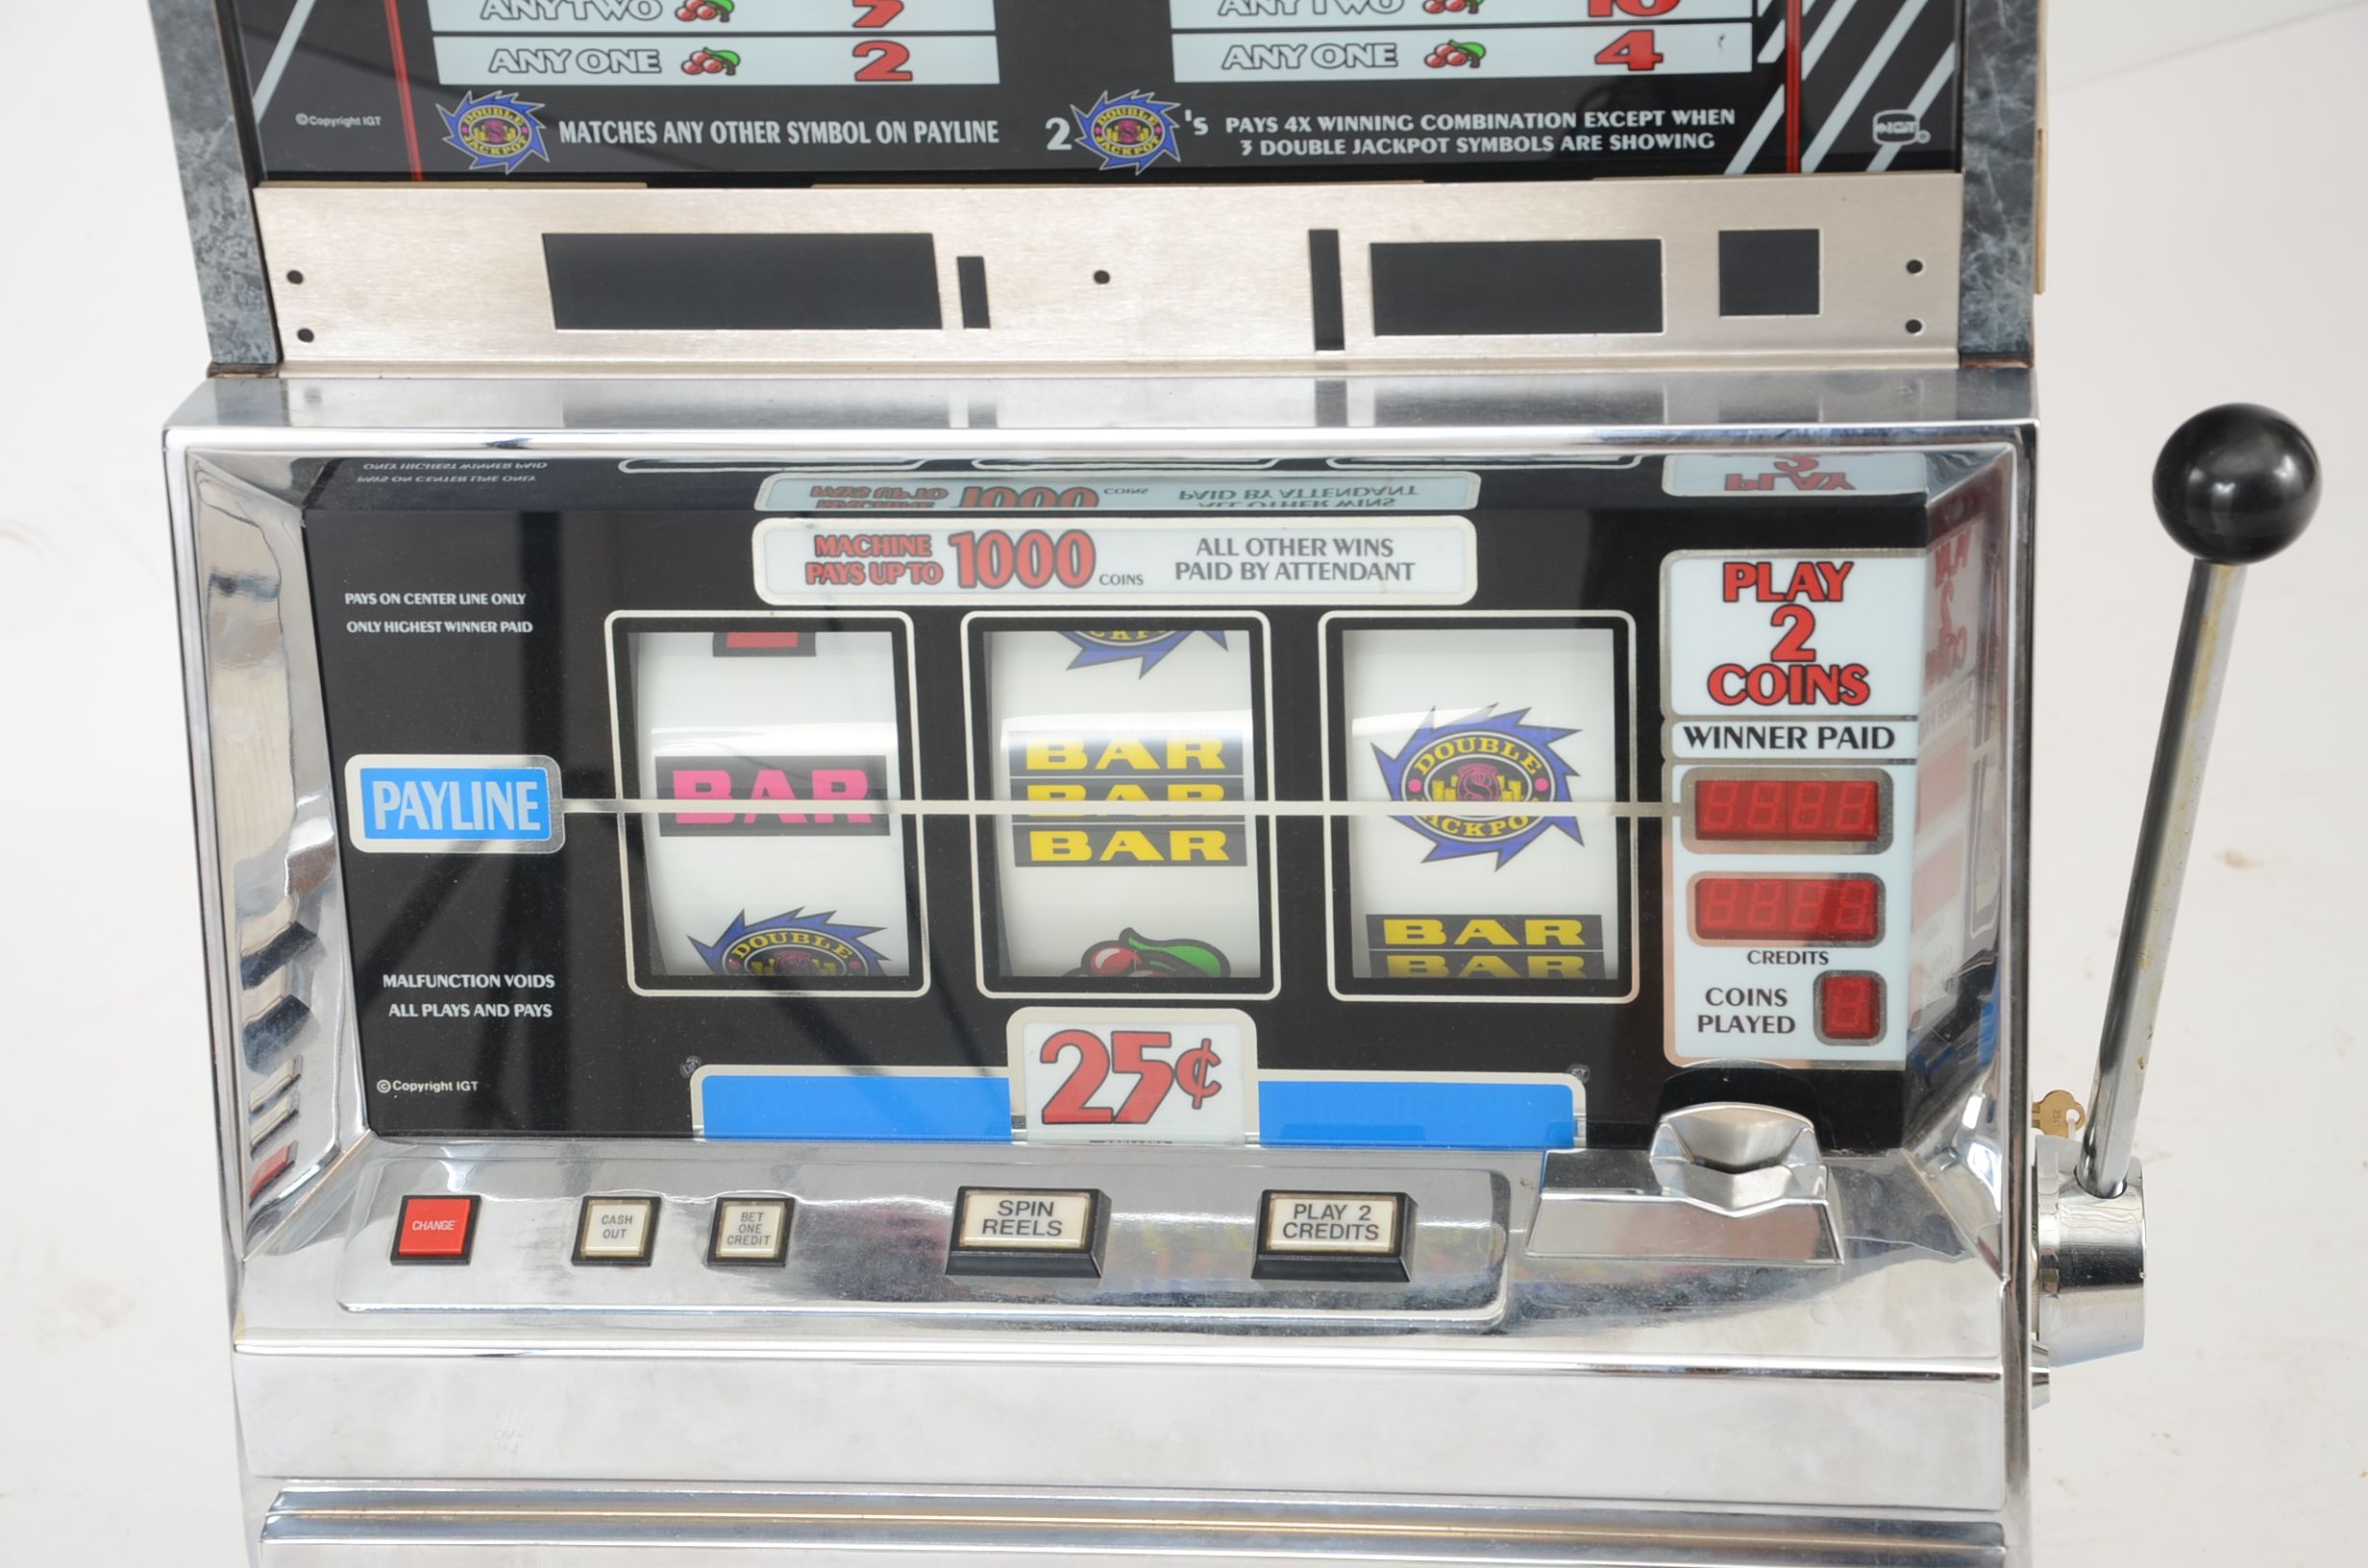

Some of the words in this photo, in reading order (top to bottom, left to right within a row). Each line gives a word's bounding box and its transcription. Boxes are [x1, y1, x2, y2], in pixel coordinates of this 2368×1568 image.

[481, 0, 568, 20] ANY
[571, 0, 662, 20] TWO
[1221, 44, 1307, 69] ANY
[1311, 43, 1398, 68] ONE
[1594, 29, 1664, 71] 4
[489, 49, 571, 74] ANY
[577, 49, 662, 74] ONE
[852, 39, 913, 82] 2
[362, 116, 382, 126] IGT
[463, 107, 526, 126] DOUBLE
[1097, 107, 1159, 126] DOUBLE
[1225, 116, 1278, 133] PAYS
[1284, 116, 1311, 133] 4X
[1318, 114, 1414, 132] WINNING
[1420, 112, 1576, 131] COMBINATION
[1584, 110, 1665, 128] EXCEPT
[1671, 109, 1735, 126] WHEN
[558, 120, 657, 144] MATCHES
[663, 121, 703, 143] ANY
[710, 120, 780, 144] OTHER
[787, 120, 872, 144] SYMBOL
[876, 120, 907, 143] ON
[914, 119, 999, 143] PAYLINE
[1045, 117, 1073, 150] 2
[1096, 135, 1161, 156] JACKPOT
[1240, 140, 1252, 156] 3
[1260, 139, 1345, 156] DOUBLE
[1351, 137, 1450, 155] JACKPOT
[1456, 135, 1555, 154] SYMBOLS
[1560, 135, 1603, 152] ARE
[1610, 133, 1714, 150] SHOWING
[814, 534, 932, 557] MACHINE
[1196, 538, 1240, 557] ALL
[1245, 537, 1327, 557] OTHER
[1332, 537, 1394, 557] WINS
[948, 528, 1097, 589] 1000
[805, 561, 866, 585] PAYS
[868, 562, 904, 584] UP
[906, 562, 945, 585] TO
[1098, 573, 1144, 586] COINS
[1174, 561, 1233, 581] PAID
[1240, 561, 1270, 581] BY
[1275, 561, 1416, 581] ATTENDANT
[1723, 561, 1855, 602] PLAY
[344, 592, 377, 605] PAYS
[379, 593, 402, 605] ON
[404, 593, 456, 605] CENTER
[458, 593, 489, 604] LINE
[491, 592, 527, 605] ONLY
[346, 621, 382, 633] ONLY
[384, 621, 441, 633] HIGHEST
[444, 621, 498, 633] WINNER
[500, 621, 533, 633] PAID
[1770, 603, 1816, 662] 2
[1707, 663, 1871, 706] COINS
[1683, 725, 1808, 749] WINNER
[1817, 725, 1896, 749] PAID
[1026, 737, 1226, 771] BAR
[1415, 737, 1542, 775] DOUBLE
[372, 781, 541, 831] PAYLINE
[673, 770, 873, 823] BAR
[1029, 829, 1230, 862] BAR
[1383, 919, 1585, 945] BAR
[730, 931, 853, 961] DOUBLE
[1386, 955, 1585, 978] BAR
[1747, 950, 1830, 966] CREDITS
[382, 974, 502, 989] MALFUNCTION
[504, 974, 555, 989] VOIDS
[1705, 987, 1788, 1007] COINS
[388, 1003, 419, 1017] ALL
[421, 1003, 471, 1017] PLAYS
[473, 1003, 510, 1017] AND
[513, 1003, 554, 1018] PAYS
[1697, 1015, 1796, 1035] PLAYED
[456, 1081, 479, 1091] IGT
[1040, 1029, 1222, 1125] 25¢
[740, 1212, 764, 1222] BET
[997, 1199, 1054, 1217] SPIN
[1294, 1203, 1347, 1221] PLAY
[1358, 1205, 1372, 1221] 2
[411, 1220, 456, 1231] CHANGE
[601, 1214, 633, 1225] CASH
[738, 1223, 762, 1235] ONE
[981, 1218, 1064, 1237] REELS
[603, 1229, 627, 1238] OUT
[727, 1236, 772, 1246] CREDIT
[1282, 1222, 1379, 1241] CREDITS
